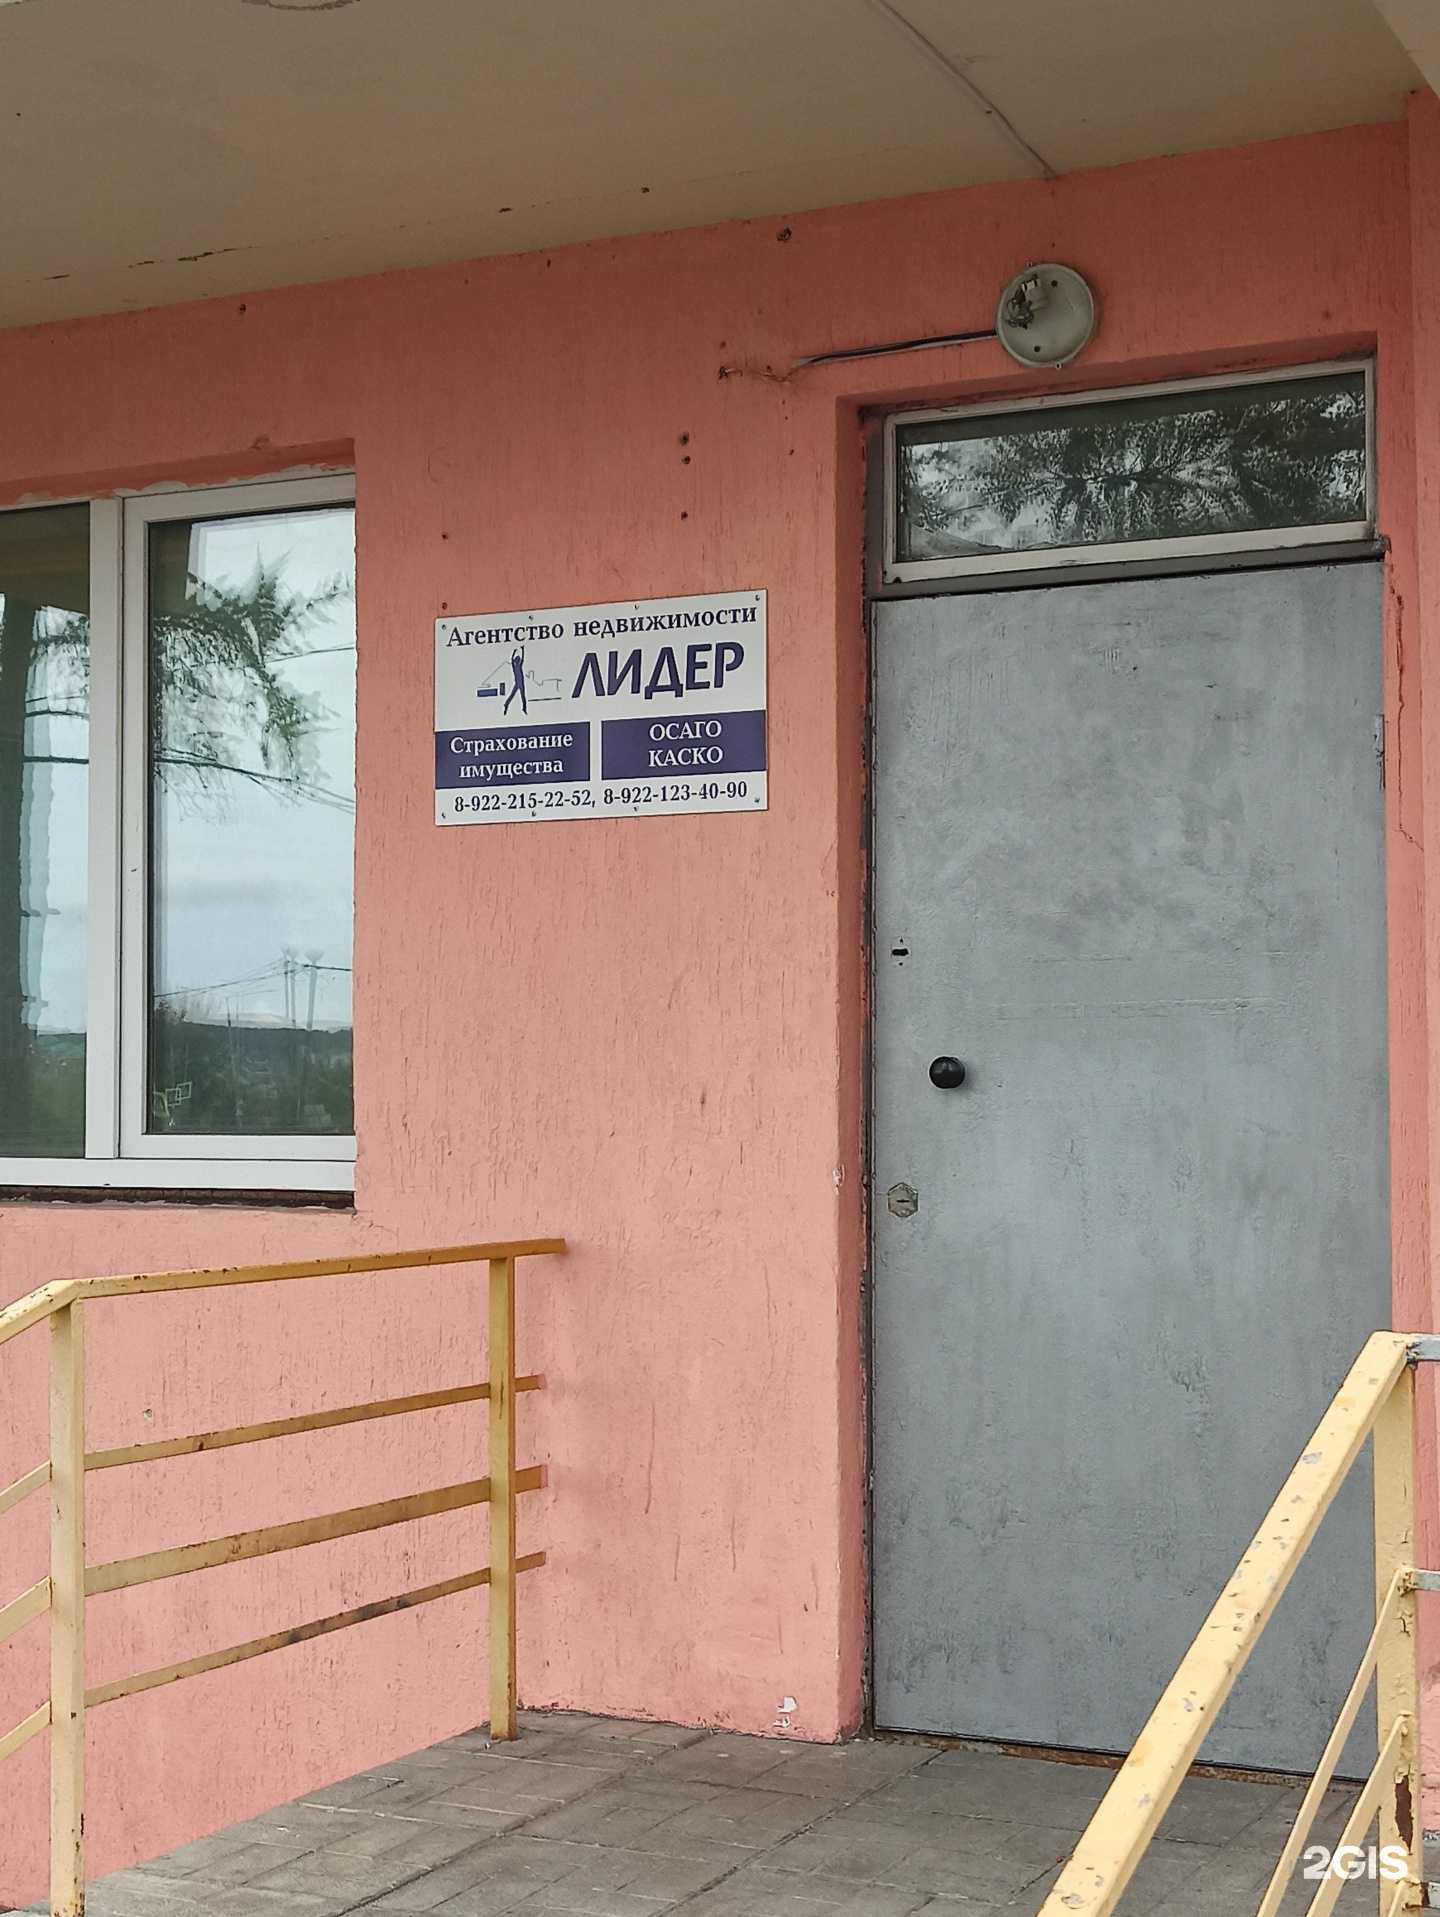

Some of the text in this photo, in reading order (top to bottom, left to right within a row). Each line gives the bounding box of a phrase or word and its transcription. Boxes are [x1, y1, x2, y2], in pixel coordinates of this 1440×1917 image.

[446, 606, 757, 648] Агентство недвижимости
[571, 641, 745, 700] ЛИДЕР
[649, 720, 722, 742] ОСАГО
[450, 732, 573, 755] Страхование
[648, 746, 723, 767] КАСКО
[458, 759, 563, 780] имущества
[454, 780, 748, 813] 8-922-215-22-52, 8-922-123-40-90
